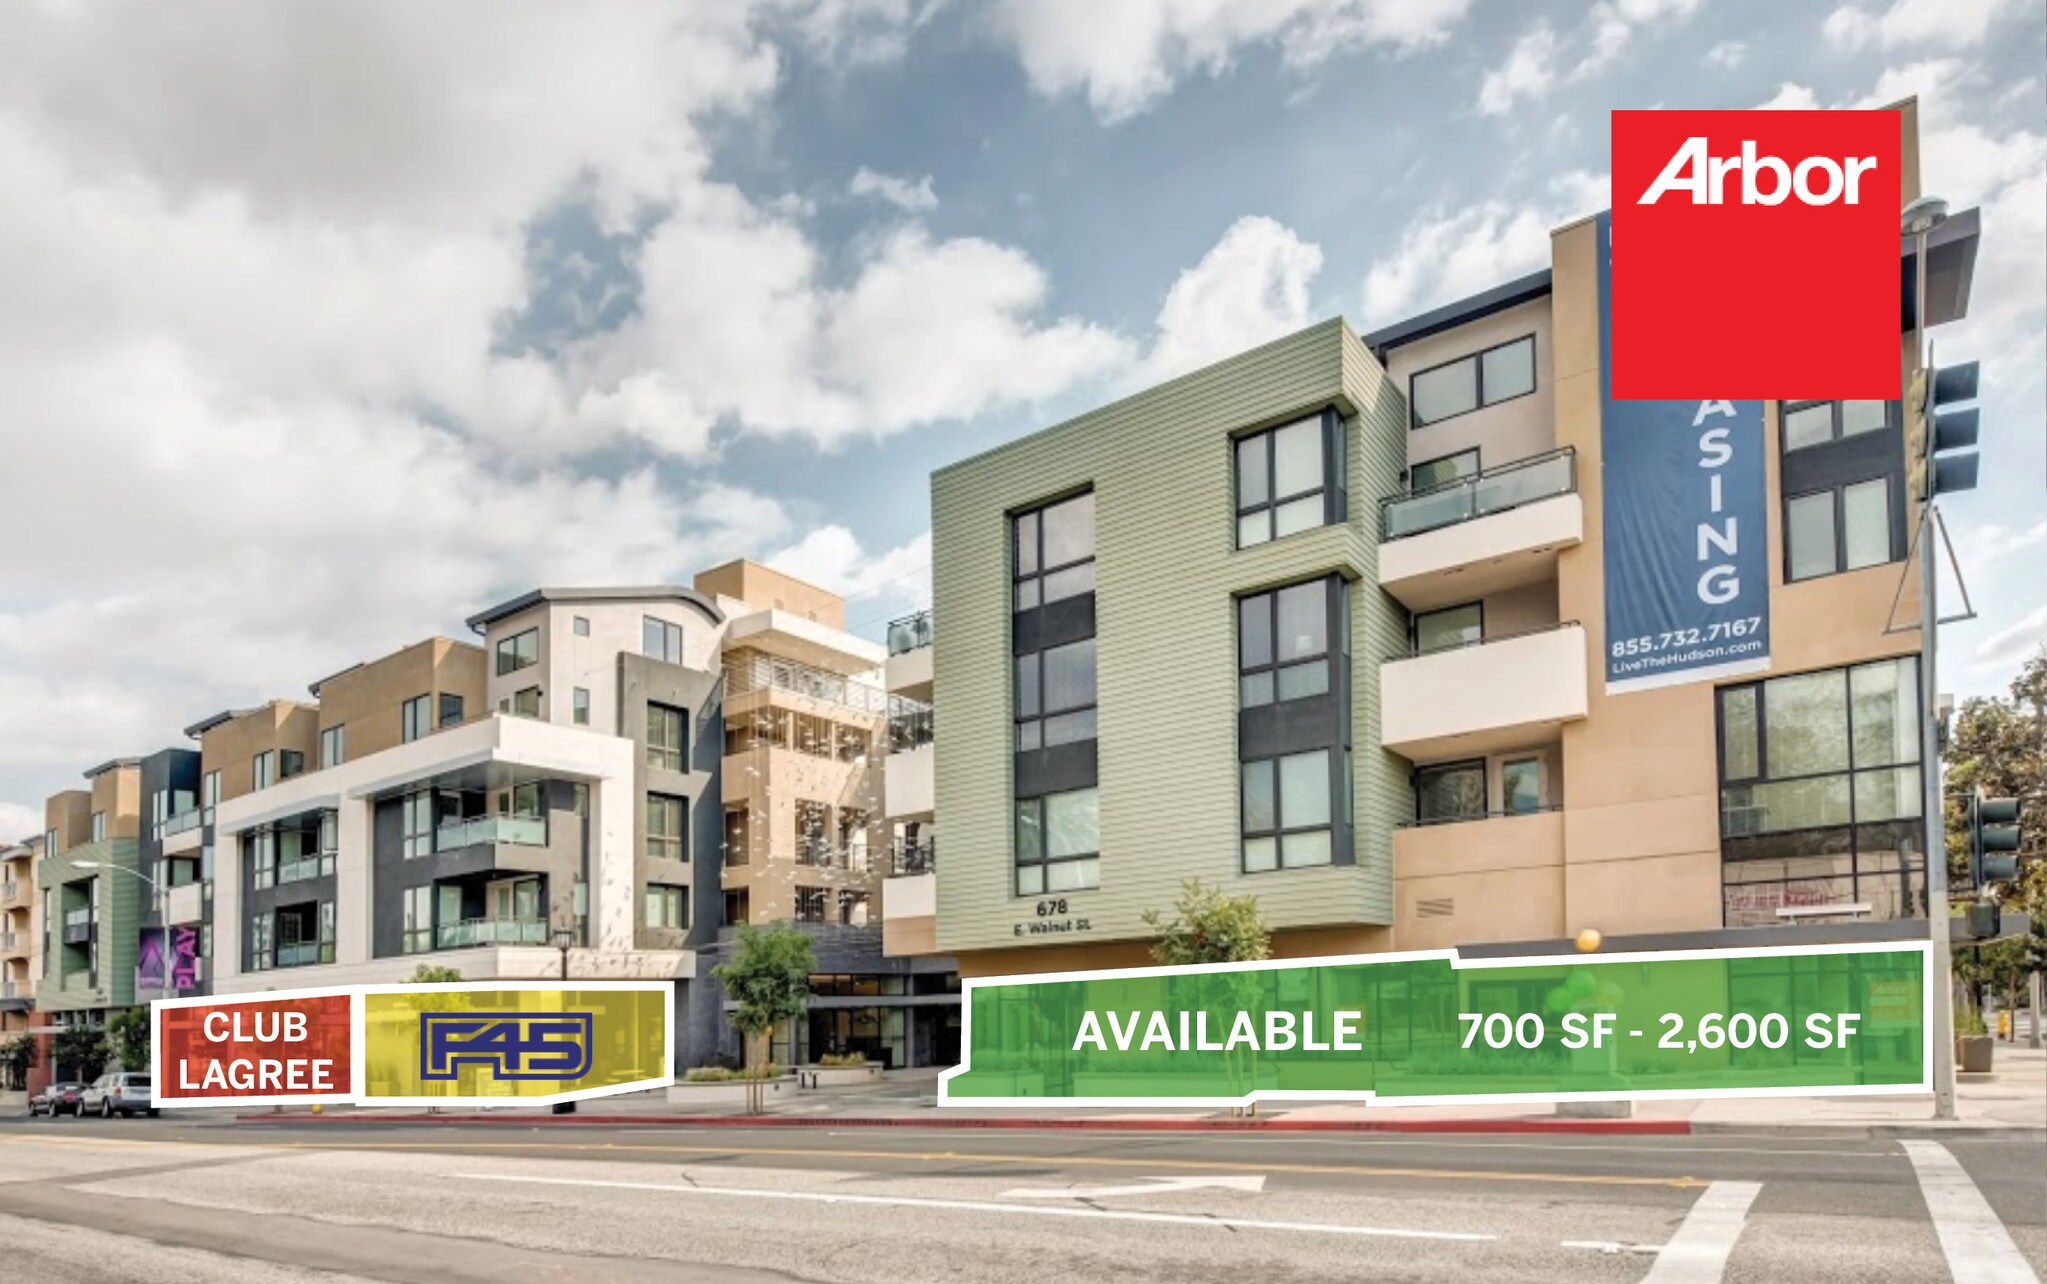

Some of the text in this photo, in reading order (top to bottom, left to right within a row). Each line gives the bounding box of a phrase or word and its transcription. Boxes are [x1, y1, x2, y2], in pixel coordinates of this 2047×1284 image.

[1612, 616, 1761, 657] 855.732.7167
[1612, 640, 1762, 674] LiveTheHudson.com
[1037, 899, 1068, 916] 678
[1029, 920, 1072, 934] Walnut
[176, 927, 196, 988] PLAY
